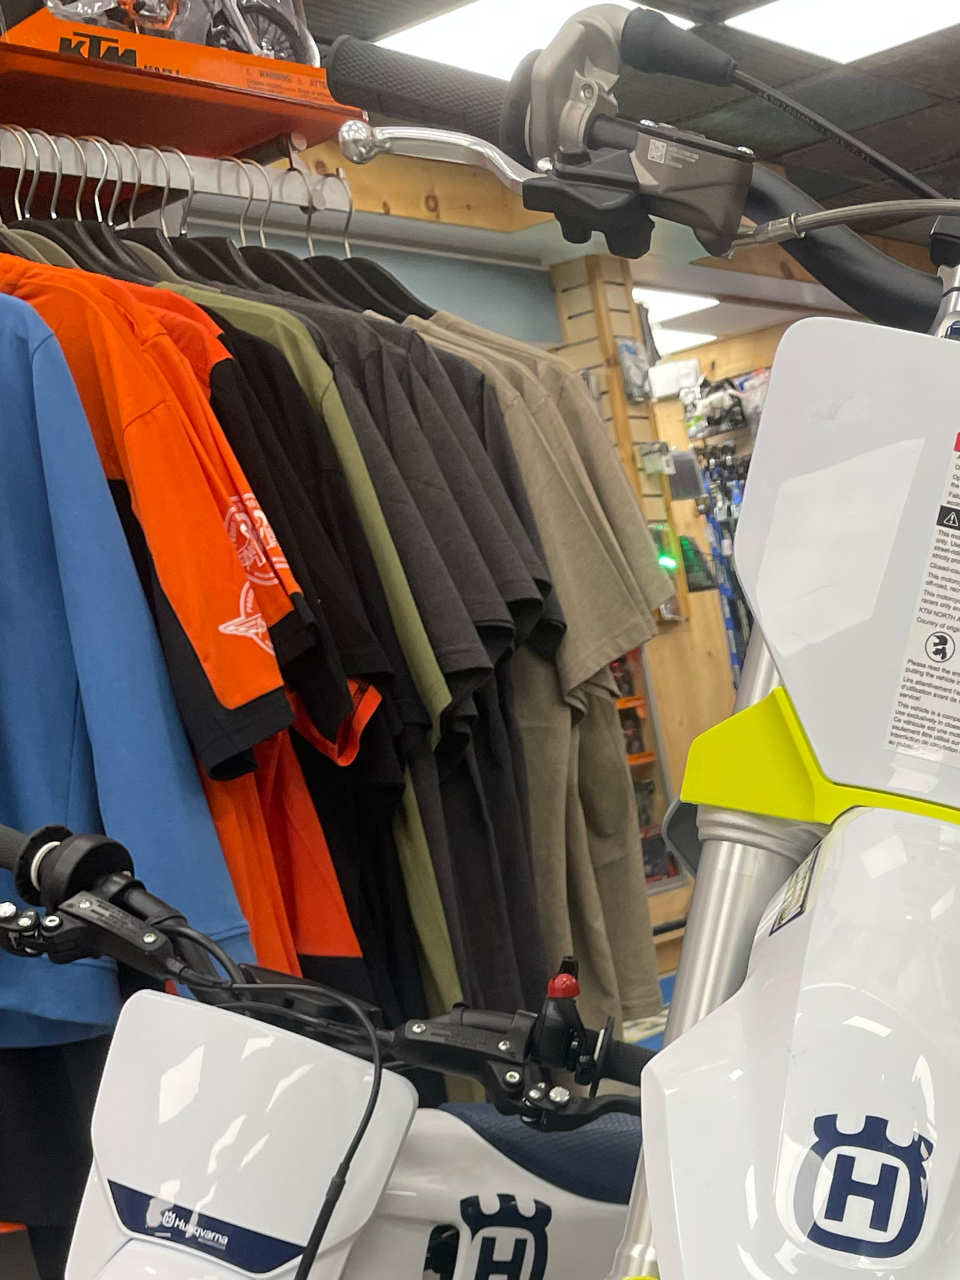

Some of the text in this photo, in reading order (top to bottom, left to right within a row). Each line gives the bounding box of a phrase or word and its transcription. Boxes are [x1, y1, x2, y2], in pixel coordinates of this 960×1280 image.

[59, 31, 137, 68] KTM
[916, 616, 938, 628] Country
[919, 607, 932, 615] KTM
[933, 611, 955, 621] NORTH
[174, 1217, 229, 1245] Husqvarna
